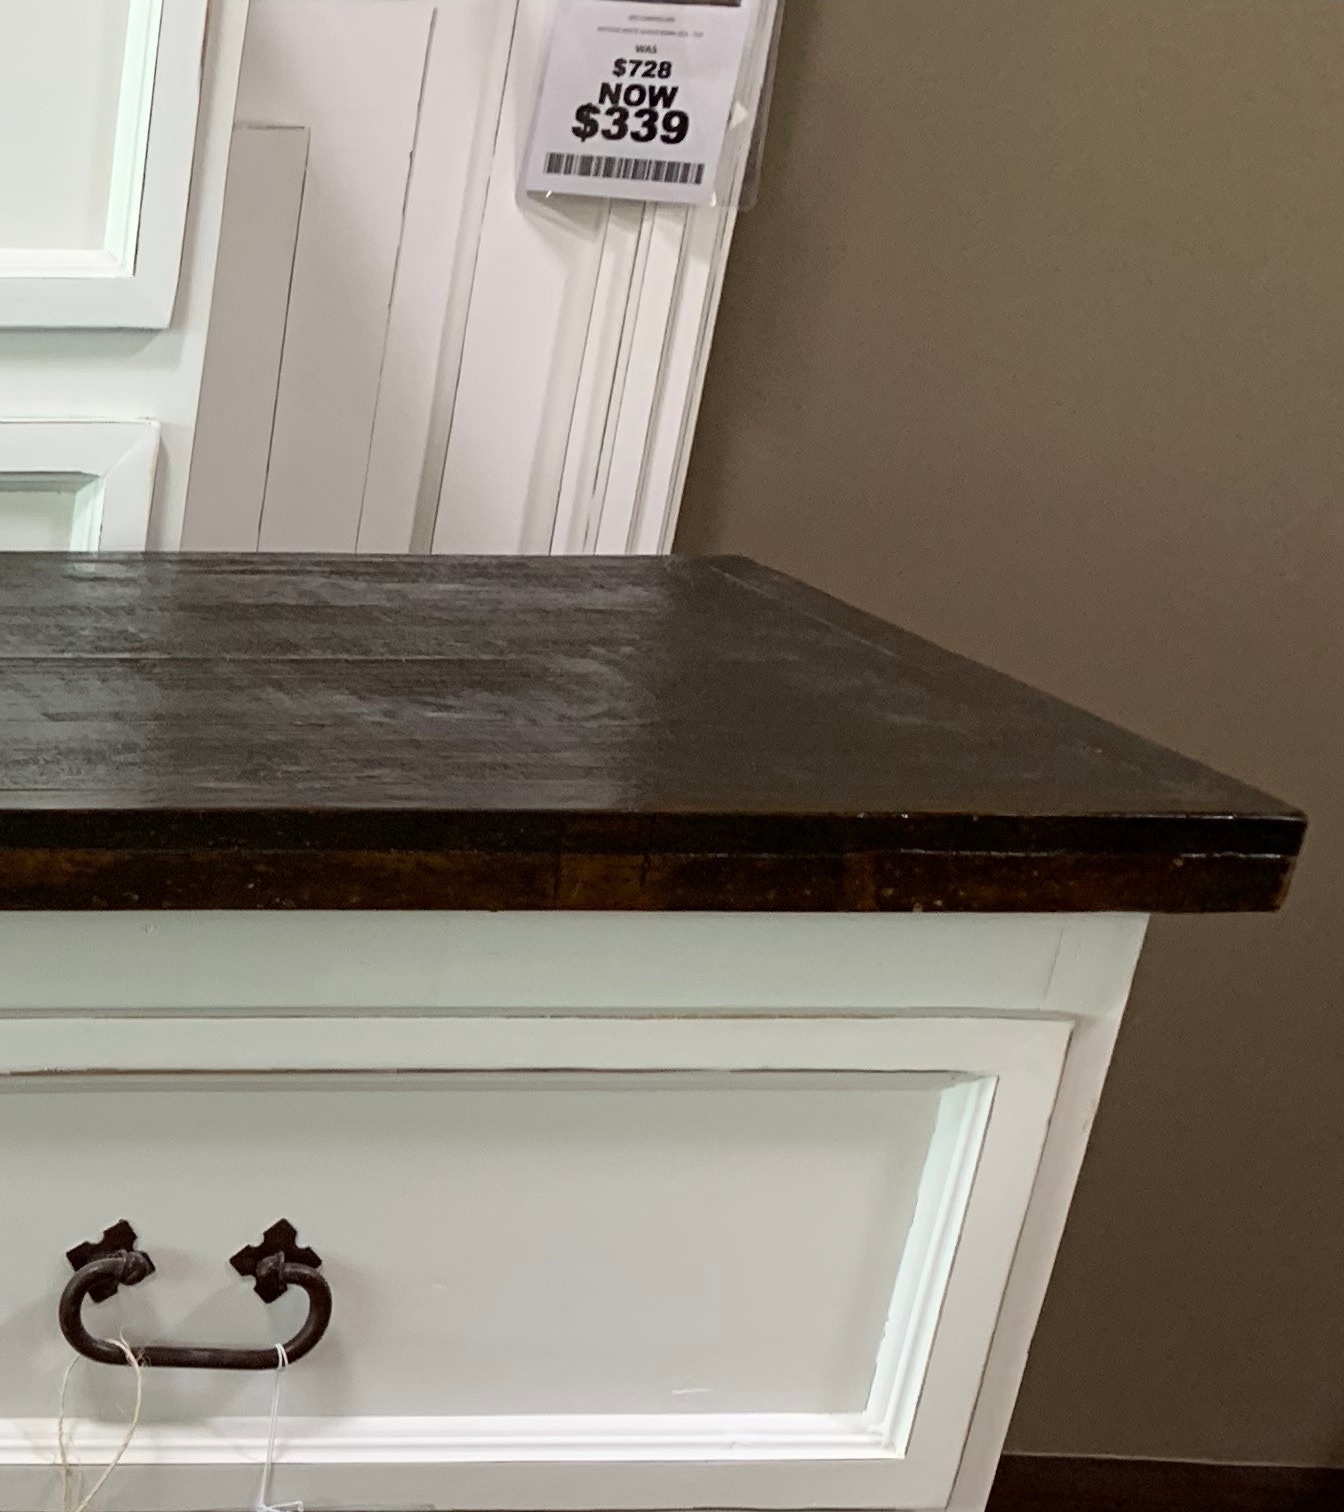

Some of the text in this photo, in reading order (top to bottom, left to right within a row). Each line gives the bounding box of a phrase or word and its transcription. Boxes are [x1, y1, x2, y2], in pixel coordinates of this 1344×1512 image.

[635, 44, 658, 54] WAS
[612, 58, 672, 79] $728
[598, 82, 679, 109] NOW
[571, 102, 690, 145] $339
